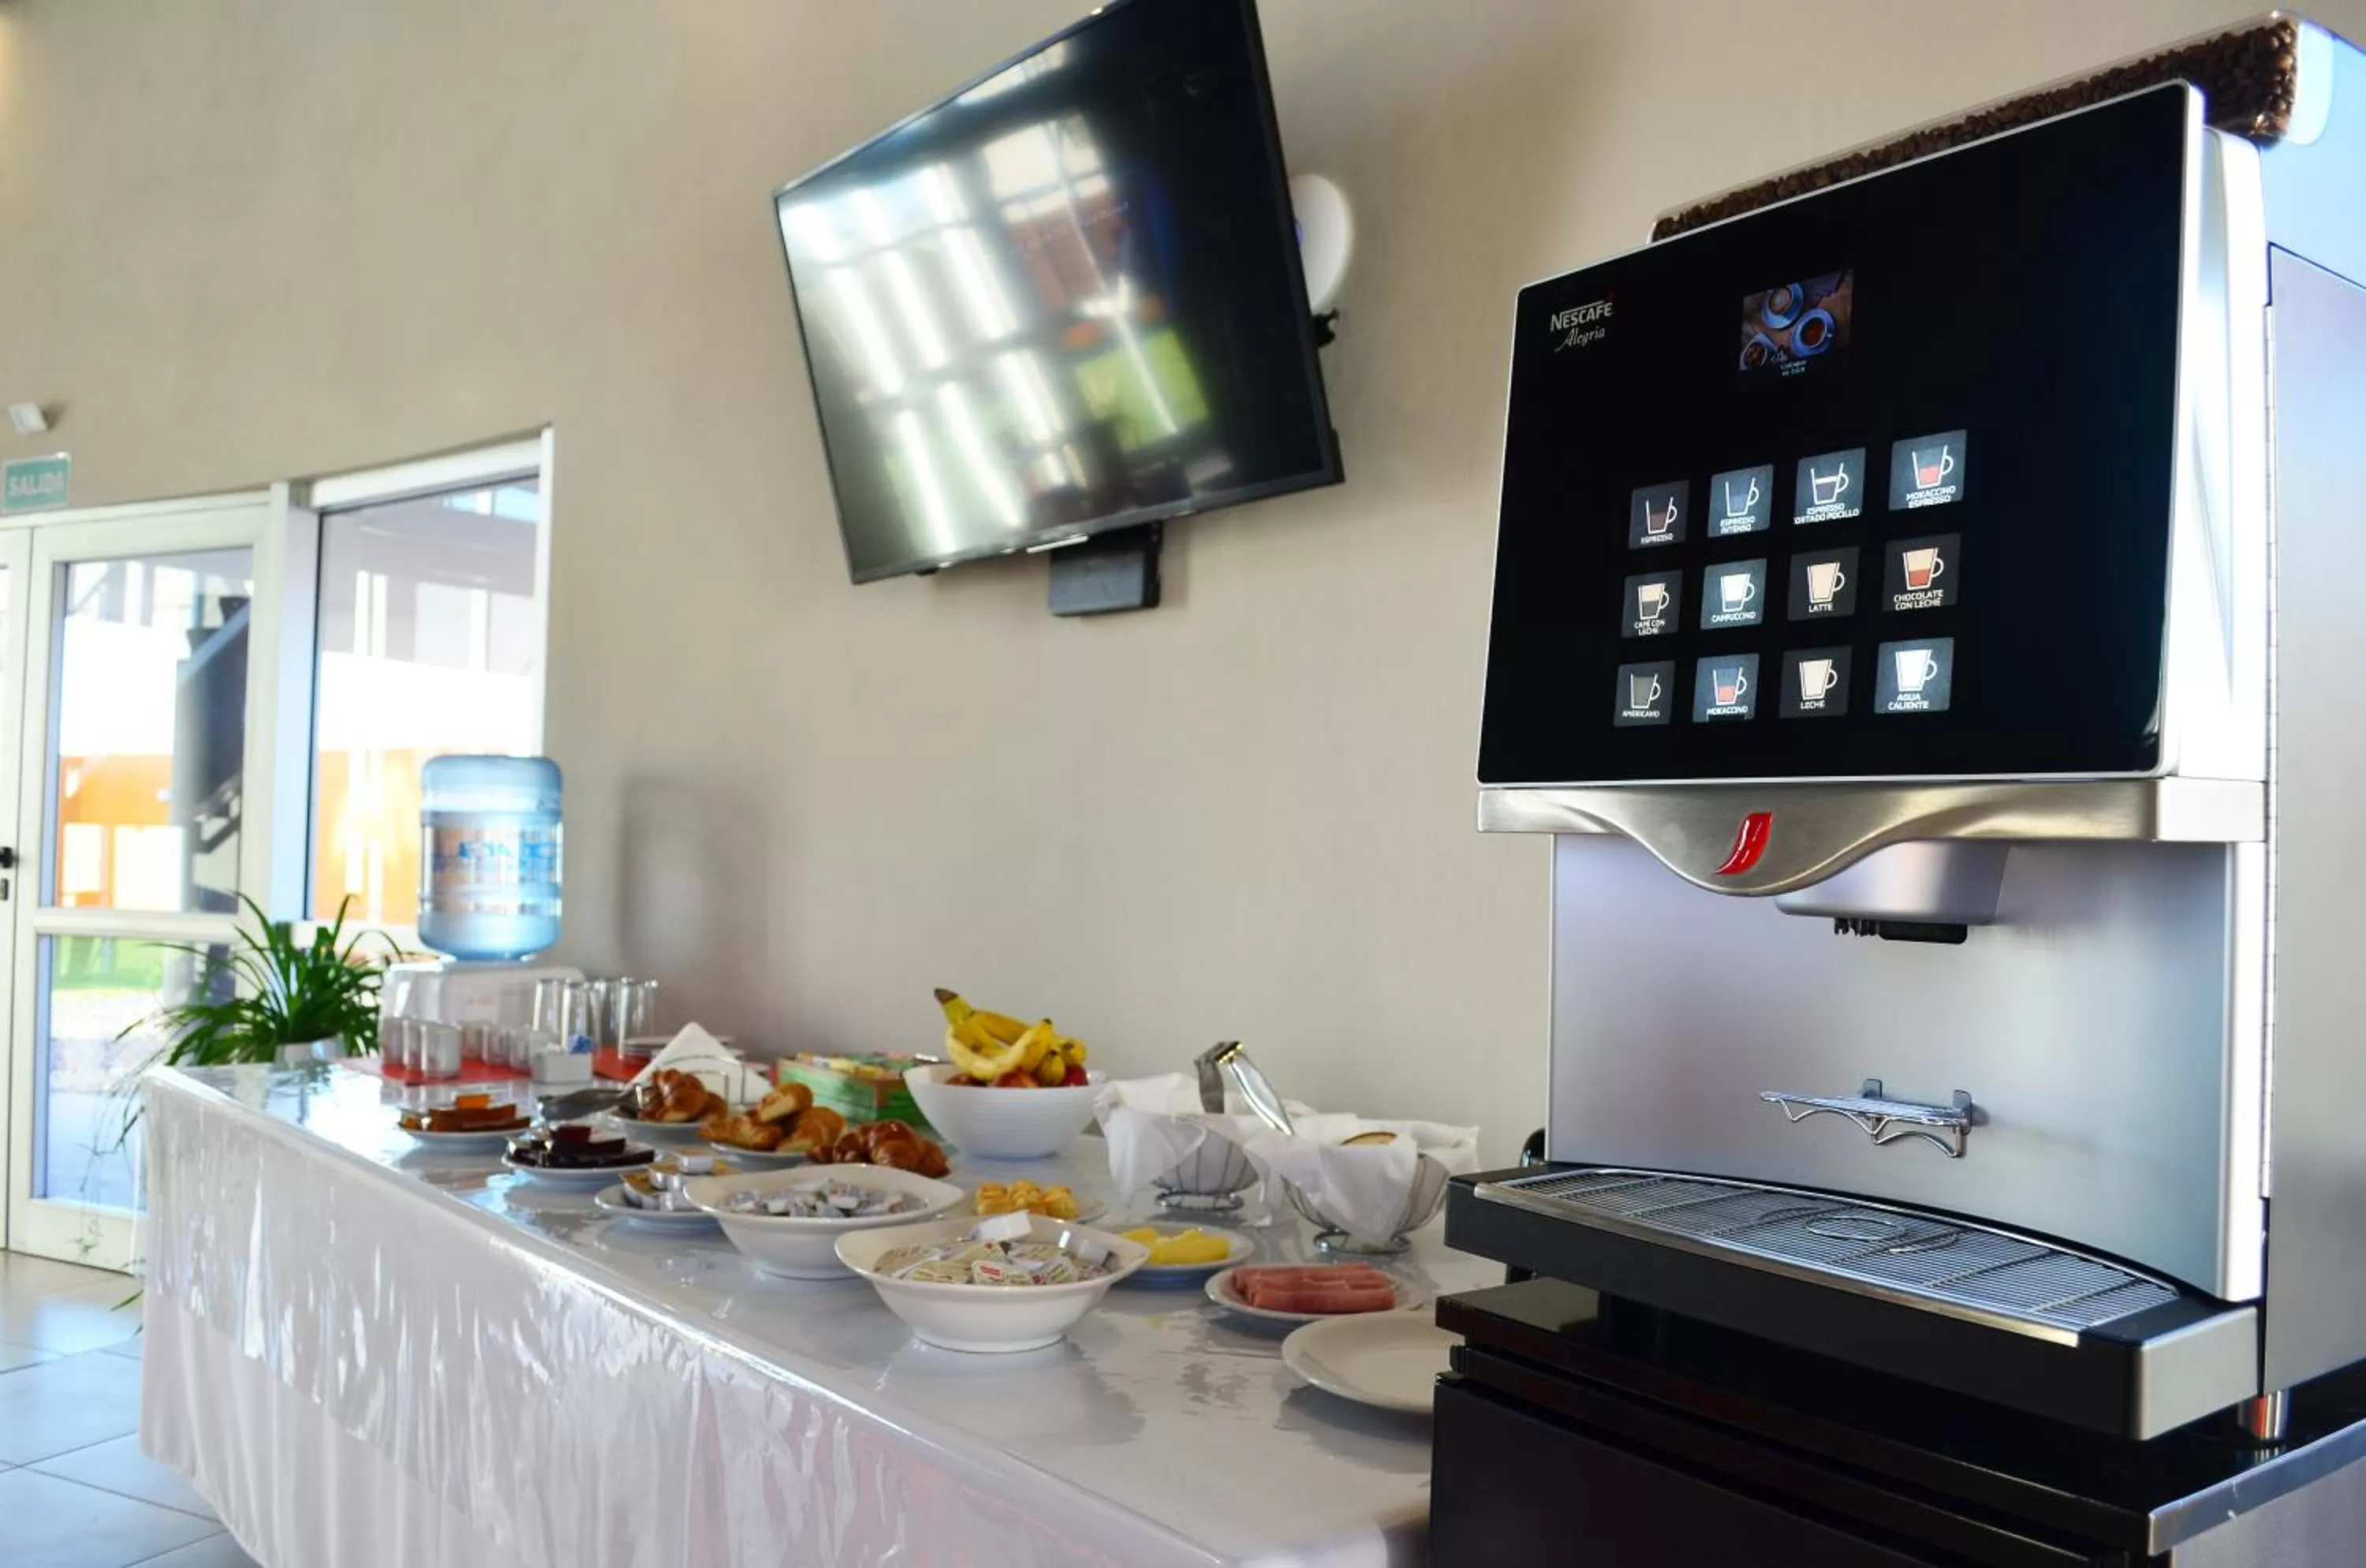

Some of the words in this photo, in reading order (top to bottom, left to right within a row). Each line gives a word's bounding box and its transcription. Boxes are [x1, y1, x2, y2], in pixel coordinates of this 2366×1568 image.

[1908, 495, 1951, 508] ESPRESSO
[1806, 503, 1845, 514] ESPRESSO
[1720, 516, 1756, 527] ESPRESSO
[1640, 533, 1674, 544] ESPRESSO
[1894, 590, 1943, 603] CHOCOLATE
[1808, 603, 1834, 612] LATTE
[1895, 601, 1913, 610] CON
[1914, 598, 1942, 608] LECHE
[1711, 612, 1756, 622] CAPPUCCINO
[1898, 693, 1921, 702] AGUA
[1801, 700, 1826, 709] LECHE
[1888, 700, 1930, 711] CALIENTE
